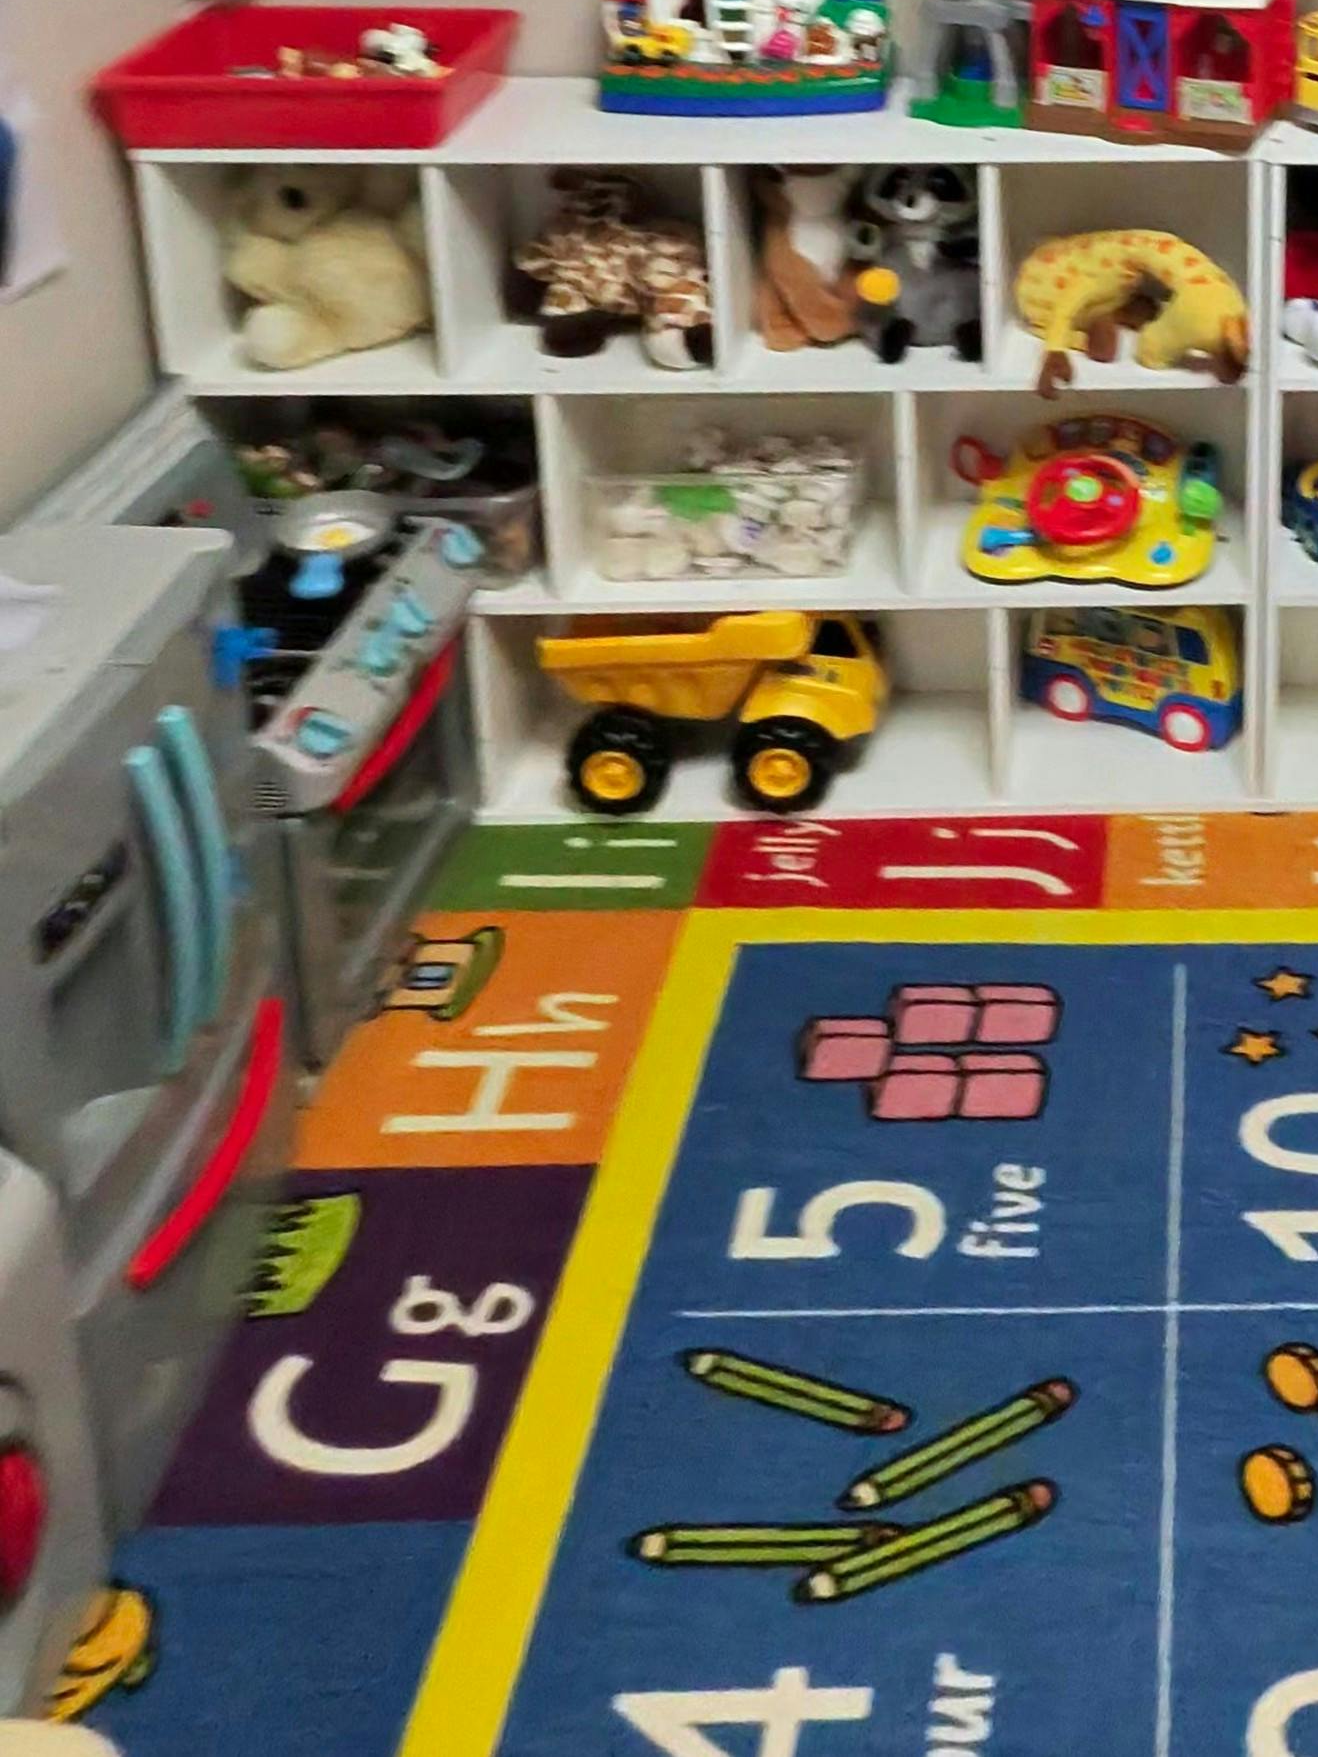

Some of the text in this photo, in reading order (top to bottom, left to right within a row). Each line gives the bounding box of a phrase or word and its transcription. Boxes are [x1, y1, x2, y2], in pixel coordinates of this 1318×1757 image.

[878, 826, 1080, 897] Jj
[380, 991, 619, 1135] Hh
[727, 1179, 947, 1261] 5
[957, 1162, 1047, 1259] five
[247, 1273, 536, 1477] Gg
[611, 1665, 875, 1757] 4
